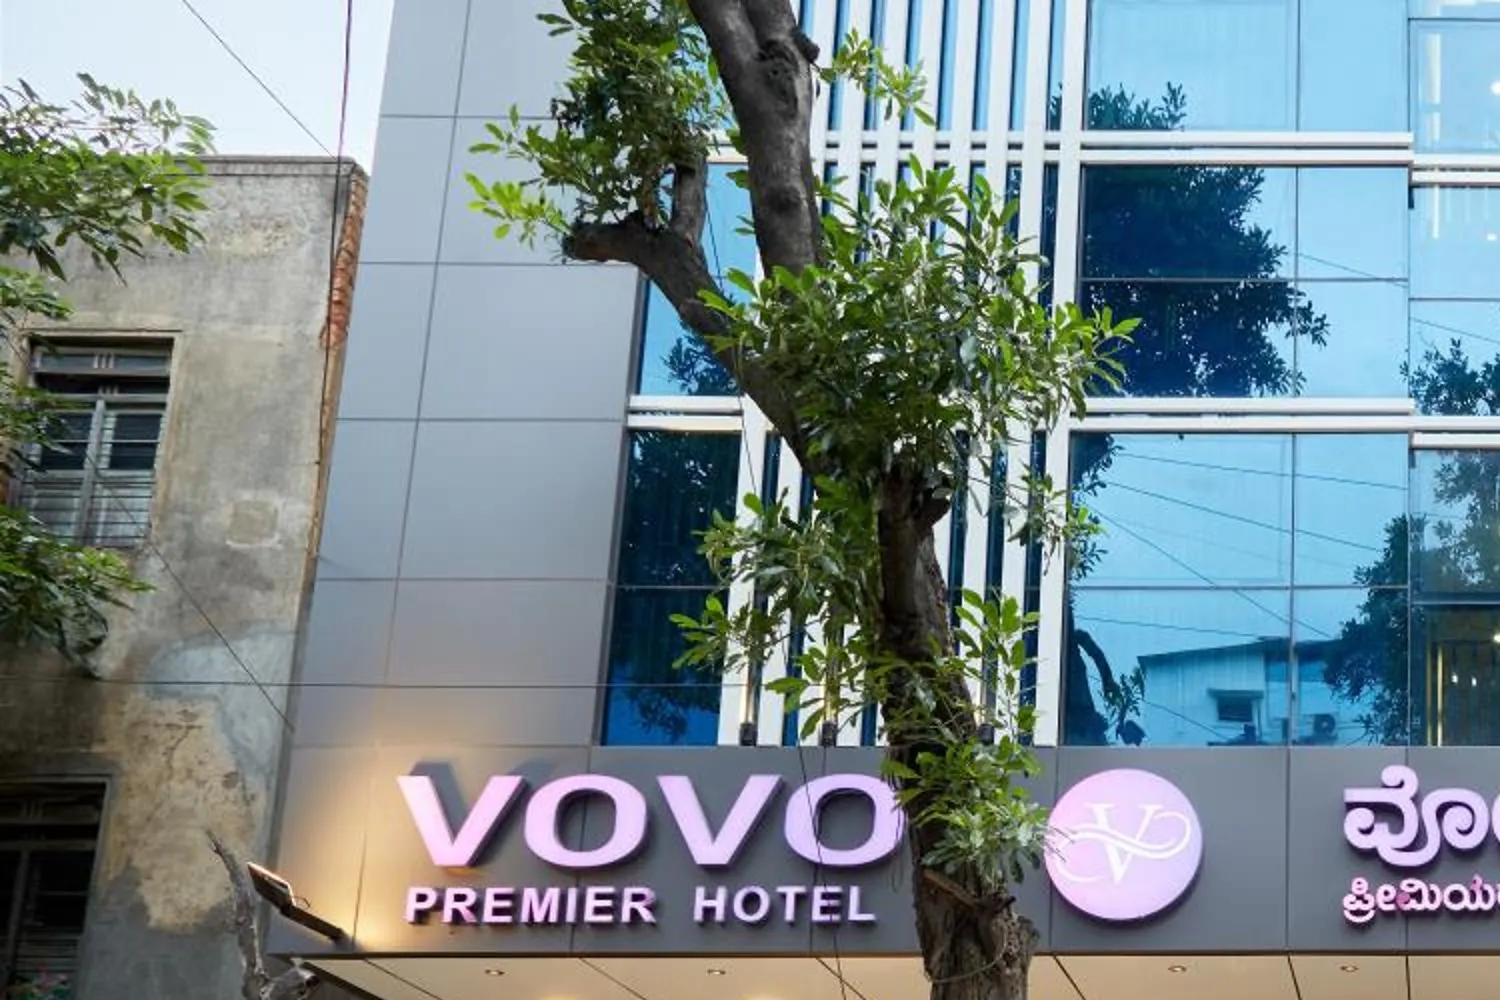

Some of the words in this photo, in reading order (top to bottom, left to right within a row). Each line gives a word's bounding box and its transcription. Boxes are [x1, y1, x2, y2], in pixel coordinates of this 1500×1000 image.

[398, 774, 907, 867] VOVO
[405, 886, 657, 923] PREMIER
[693, 886, 877, 922] HOTEL
